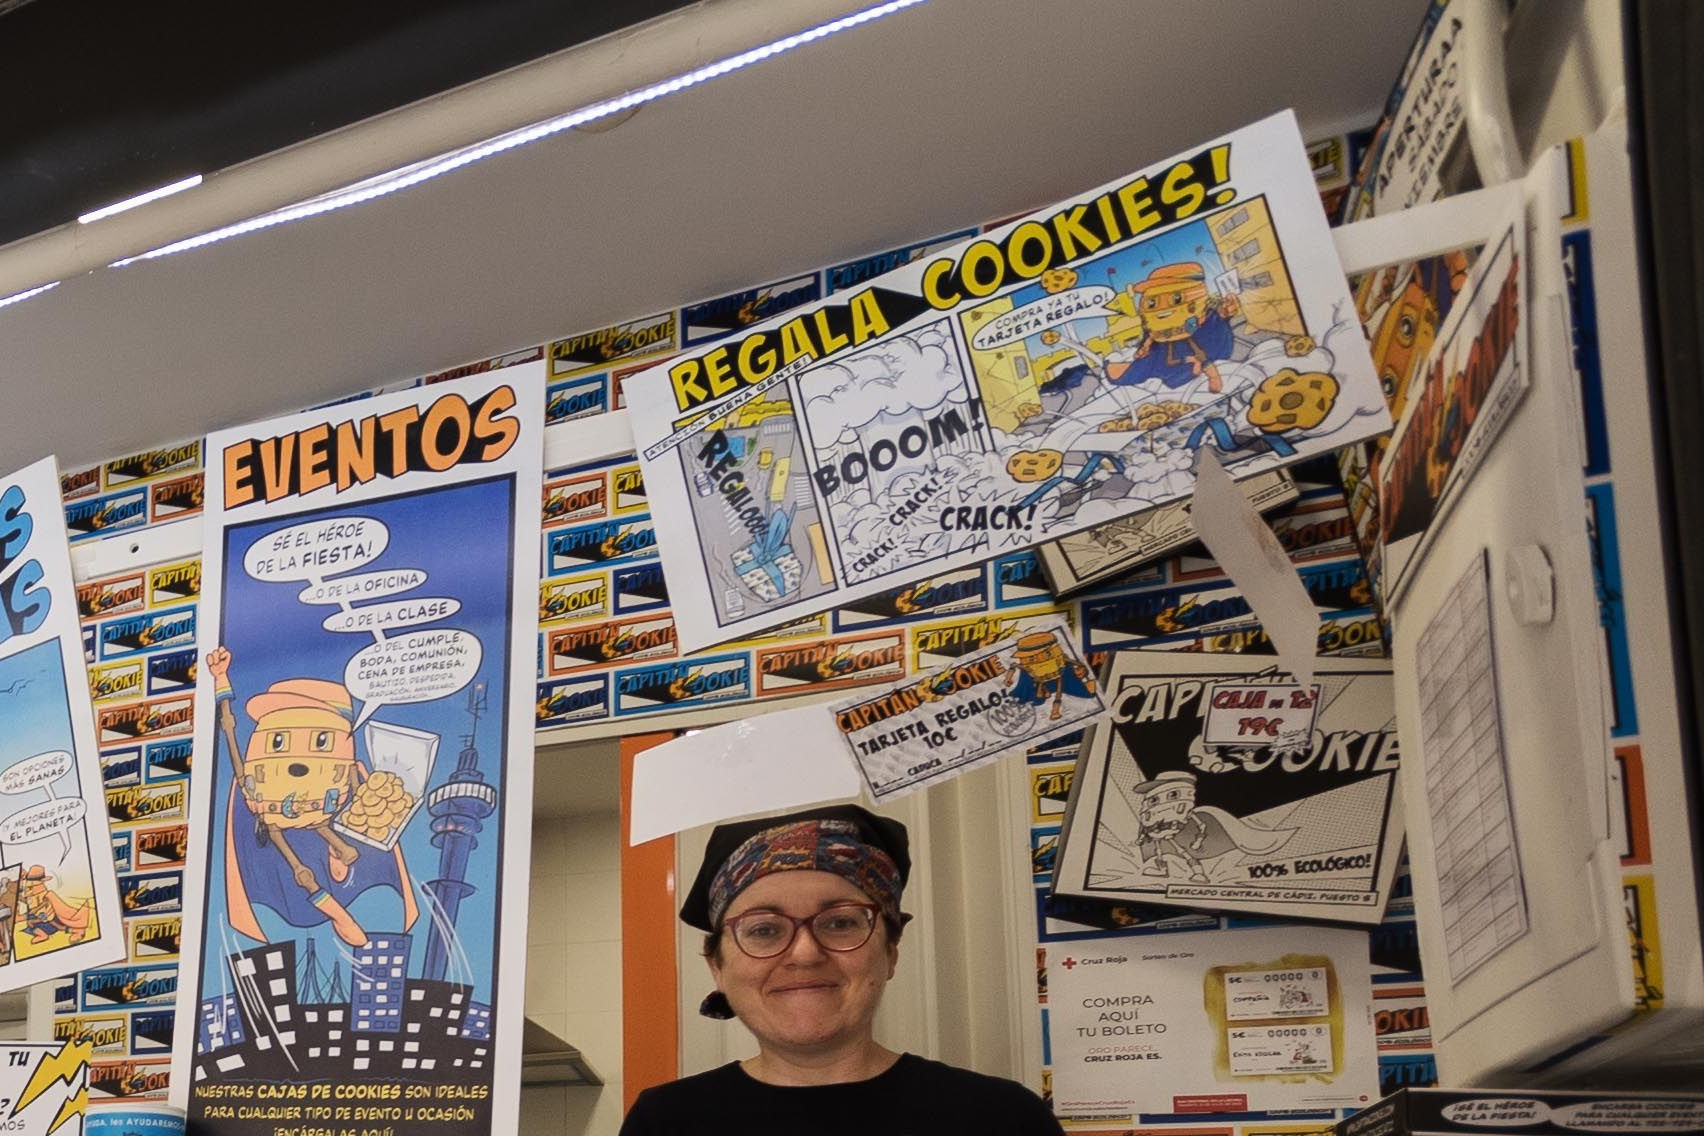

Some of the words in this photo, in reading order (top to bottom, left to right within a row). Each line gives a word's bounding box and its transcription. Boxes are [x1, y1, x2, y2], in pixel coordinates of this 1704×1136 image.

[669, 286, 891, 413] REGALA
[920, 143, 1238, 312] COOKIES!
[977, 317, 1042, 348] TARJETA
[1046, 290, 1110, 324] REGALO!
[995, 305, 1045, 330] COMPRA
[708, 391, 755, 420] BUENA
[756, 357, 811, 391] GENTE!
[223, 384, 521, 512] EVENTOS
[812, 398, 984, 498] BOOOM!
[889, 476, 943, 528] CRACK!
[939, 504, 1038, 533] CRACK!
[272, 526, 292, 552] SÉ
[317, 521, 366, 544] HÉROE
[256, 558, 274, 575] DE
[302, 541, 373, 568] FIESTA!
[852, 537, 898, 574] CRACK!
[364, 572, 419, 593] OFICINA
[397, 600, 448, 621] CLASE
[357, 668, 388, 681] CENA
[917, 655, 1008, 702] COOKIE
[1212, 689, 1268, 711] CAJA
[857, 720, 930, 756] TARJETA
[934, 688, 1011, 728] REGALO!
[1238, 717, 1284, 737] 19€
[923, 727, 959, 751] 10€
[28, 765, 65, 785] SANAS
[1248, 864, 1289, 879] 100%
[1294, 853, 1373, 875] ECOLÓGICO!
[1081, 958, 1103, 966] Cruz
[1106, 955, 1128, 965] Roja
[1082, 995, 1154, 1009] COMPRA
[1098, 1008, 1139, 1023] AQUÍ
[1077, 1027, 1096, 1038] TU
[1102, 1023, 1167, 1037] BOLETO
[9, 1051, 29, 1066] TU
[1084, 1055, 1112, 1063] CRUZ
[1115, 1053, 1144, 1062] ROJA
[196, 1085, 254, 1099] NUESTRAS
[257, 1084, 308, 1099] CAJAS
[311, 1085, 331, 1099] DE
[335, 1084, 401, 1100] COOKIES
[404, 1085, 431, 1099] SON
[435, 1085, 488, 1100] IDEALES
[204, 1106, 235, 1119] PARA
[238, 1106, 301, 1120] CUALQUIER
[304, 1106, 332, 1120] TIPO
[335, 1107, 351, 1120] DE
[354, 1107, 401, 1120] EVENTO
[417, 1104, 475, 1121] OCASIÓN
